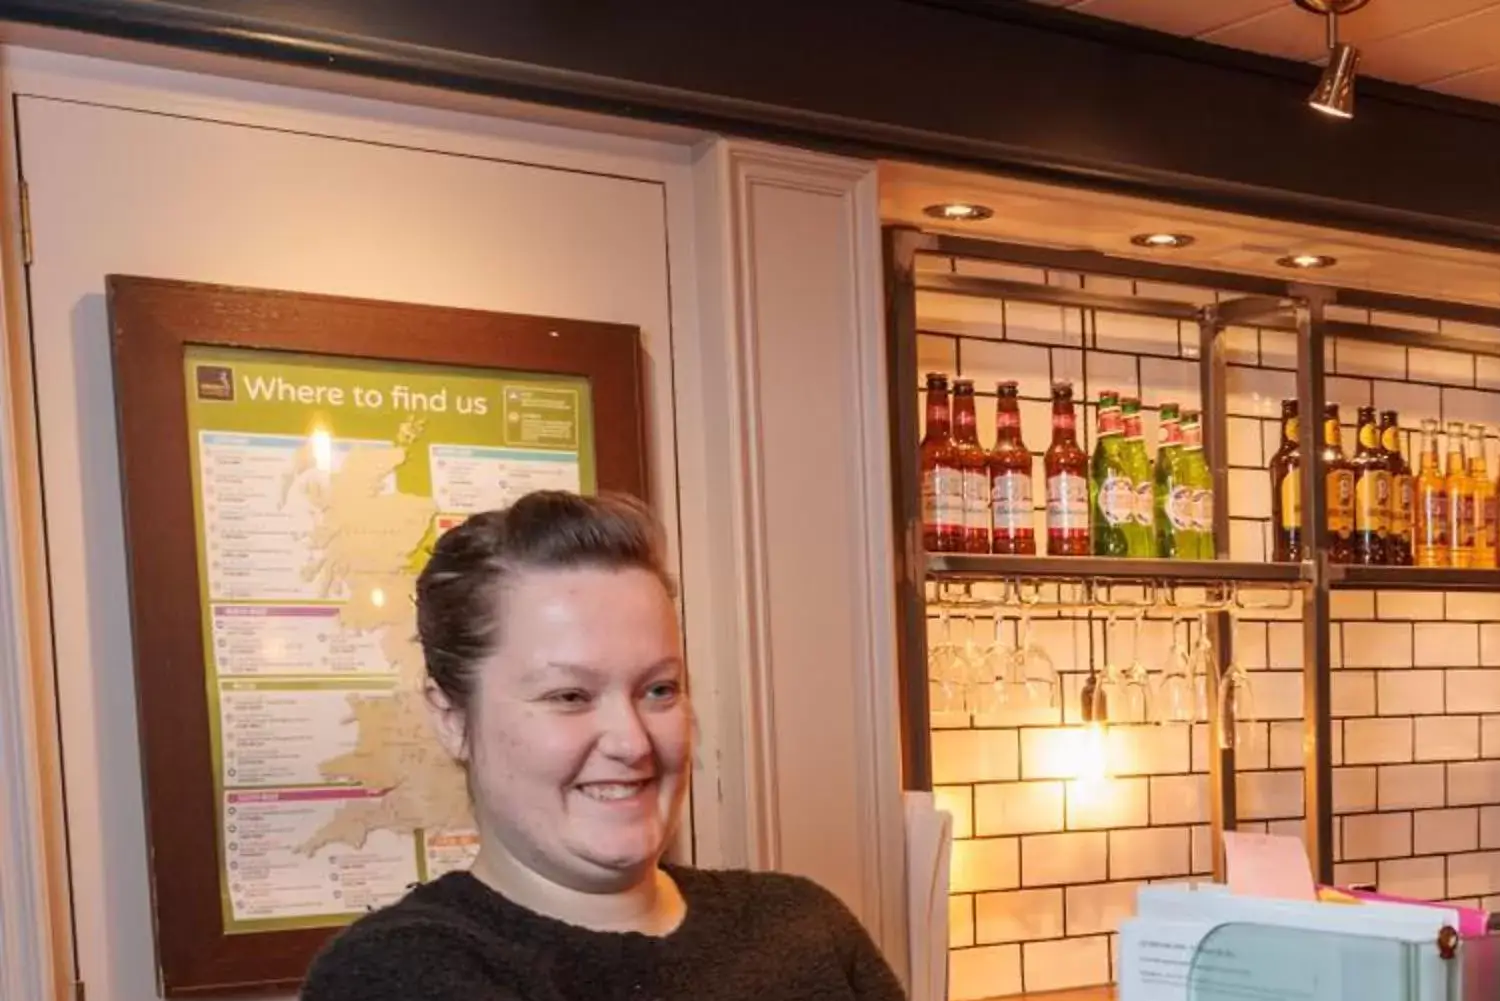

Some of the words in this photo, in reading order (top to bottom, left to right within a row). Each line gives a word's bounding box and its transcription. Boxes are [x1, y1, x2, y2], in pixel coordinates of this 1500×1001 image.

[243, 375, 345, 406] Where
[352, 385, 384, 408] to
[391, 385, 447, 412] find
[456, 395, 489, 415] us
